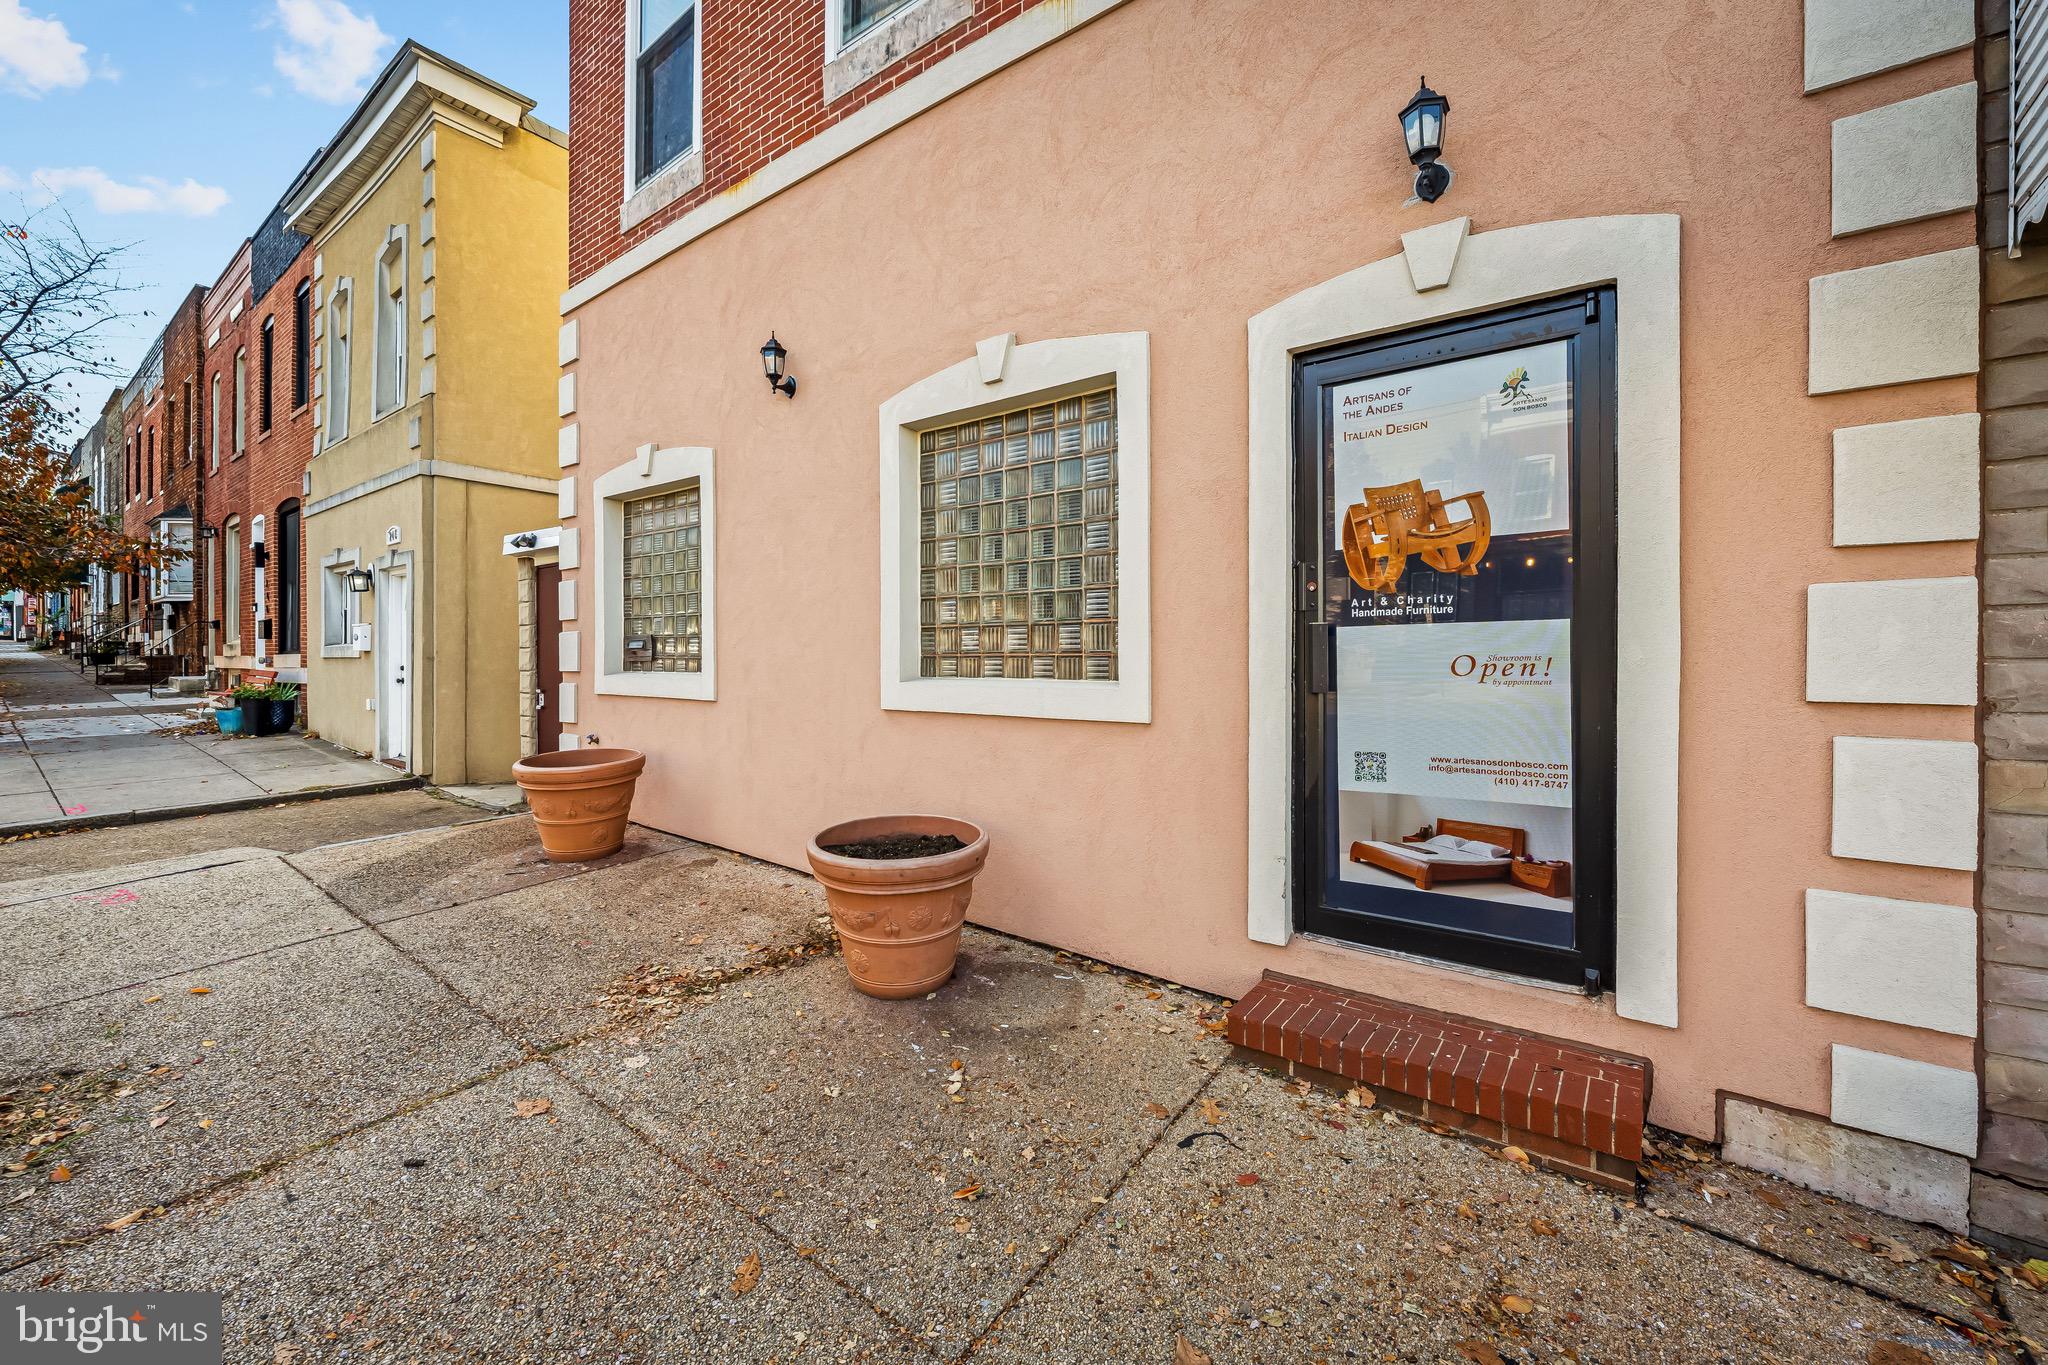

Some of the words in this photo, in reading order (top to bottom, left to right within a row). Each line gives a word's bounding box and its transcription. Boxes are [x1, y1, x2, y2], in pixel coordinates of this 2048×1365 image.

[1512, 396, 1548, 407] ARTESANOS
[1351, 598, 1373, 608] Art
[1380, 596, 1388, 606] &
[1396, 593, 1454, 605] Charity
[1351, 607, 1403, 618] Handmade
[1406, 605, 1454, 615] Furniture
[1486, 654, 1532, 662] Showroom
[1534, 653, 1542, 661] is
[1450, 654, 1553, 684] Open!
[1492, 679, 1501, 687] by
[1502, 679, 1552, 687] appointment
[1430, 755, 1569, 771] www.artesanosdonbosco.com
[1428, 764, 1569, 780] info@artesanosdonbosco.com
[1494, 777, 1519, 788] (410)
[1522, 779, 1568, 790] 417-8747
